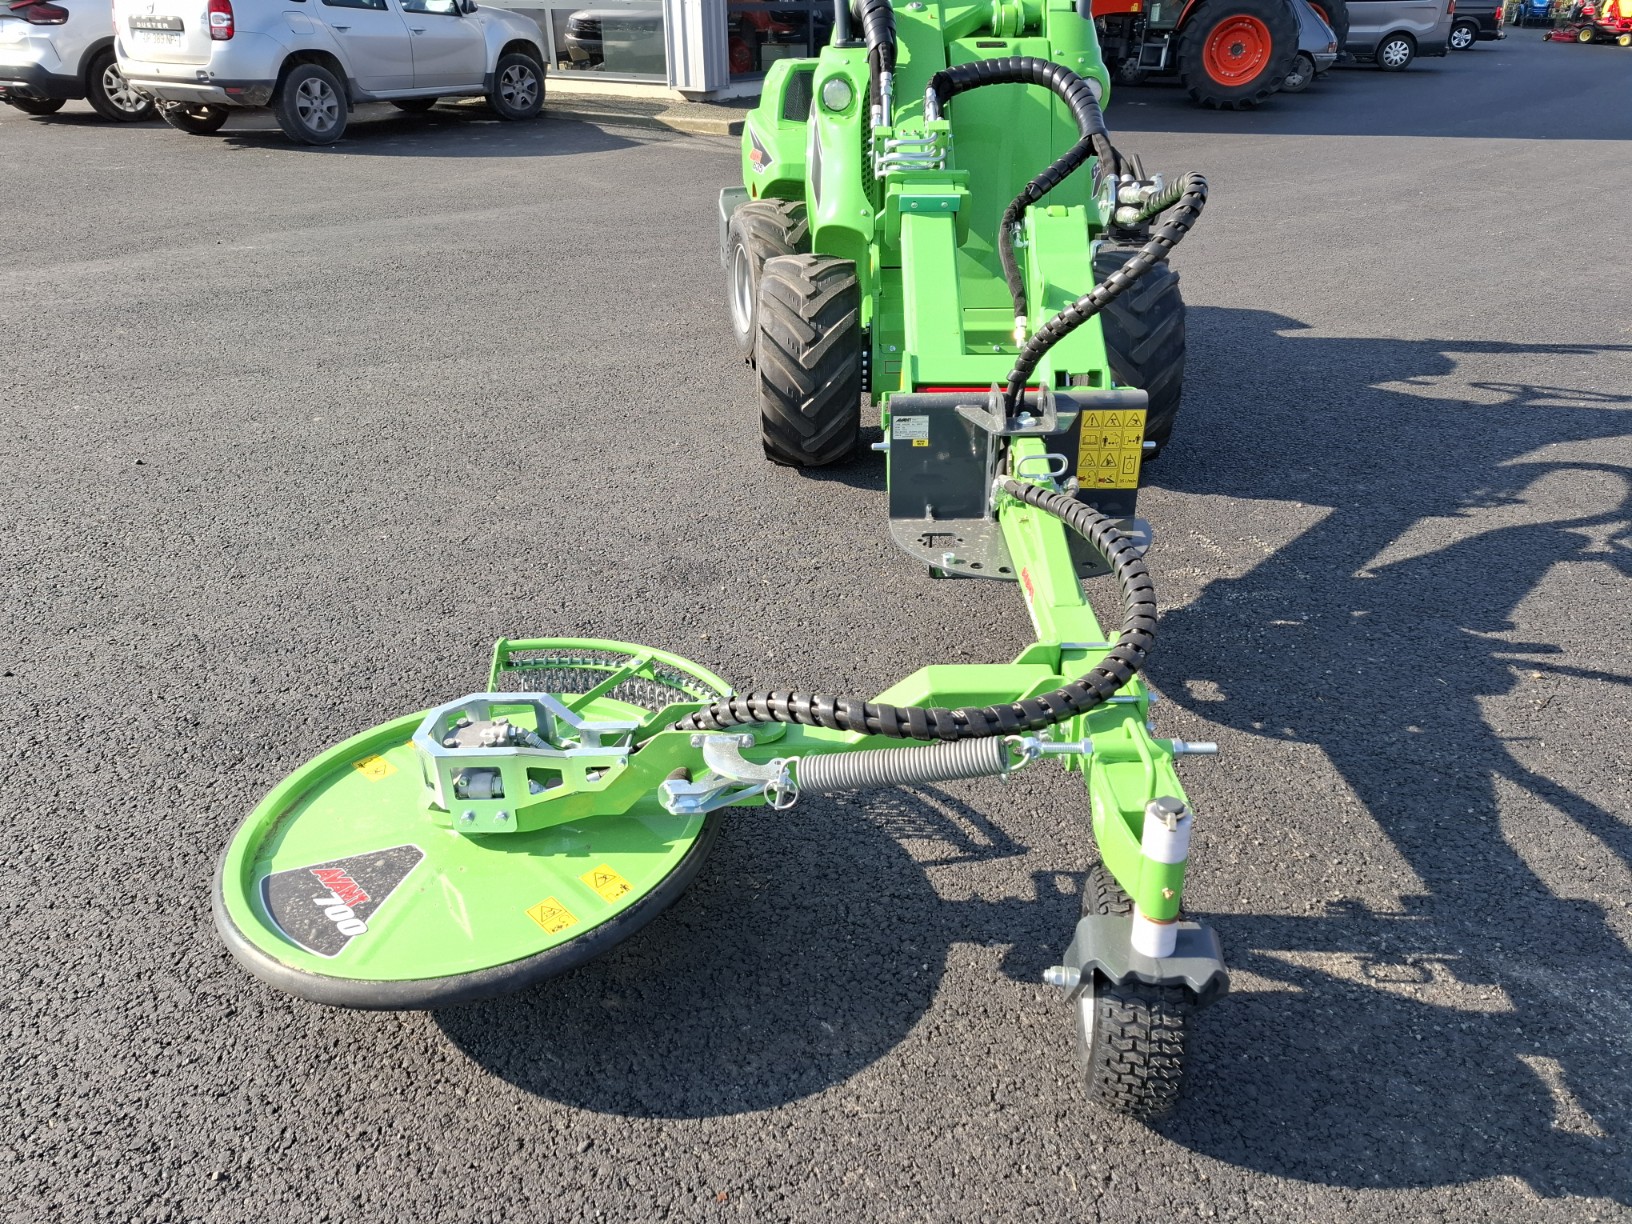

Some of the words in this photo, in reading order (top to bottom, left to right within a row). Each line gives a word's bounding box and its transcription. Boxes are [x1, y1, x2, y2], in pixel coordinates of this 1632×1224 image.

[752, 161, 764, 173] 635
[309, 868, 371, 908] AVANT
[313, 891, 369, 936] 700
